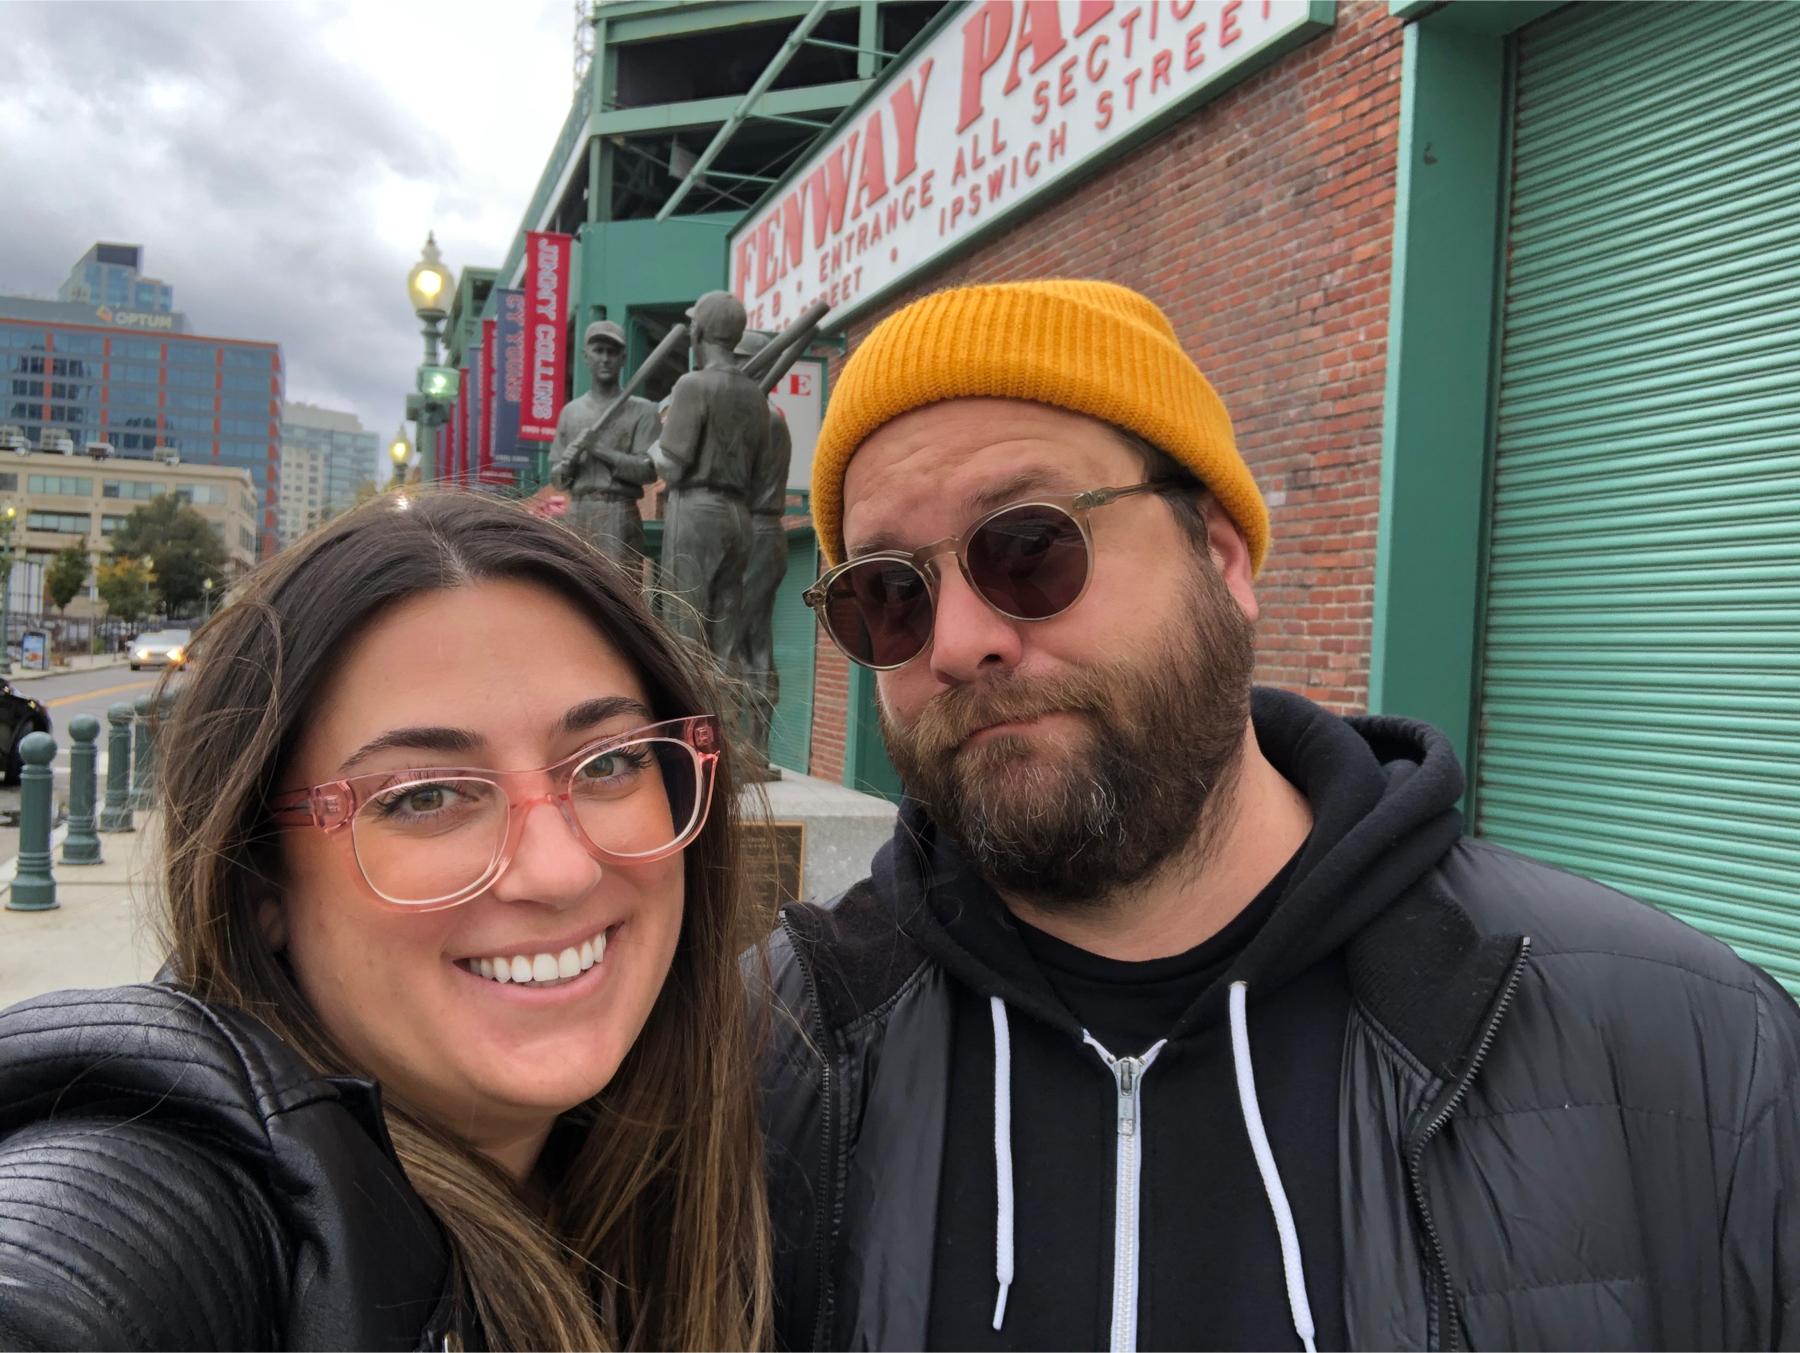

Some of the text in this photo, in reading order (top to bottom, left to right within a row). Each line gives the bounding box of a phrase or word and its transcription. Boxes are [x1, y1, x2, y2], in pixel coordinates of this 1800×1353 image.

[735, 58, 935, 305] FENWAY
[819, 168, 935, 283] ENTRANCE
[951, 117, 1007, 187] ALL
[940, 121, 1068, 237] IPSWICH
[115, 311, 172, 328] OPTUM
[532, 323, 556, 419] COLLINS
